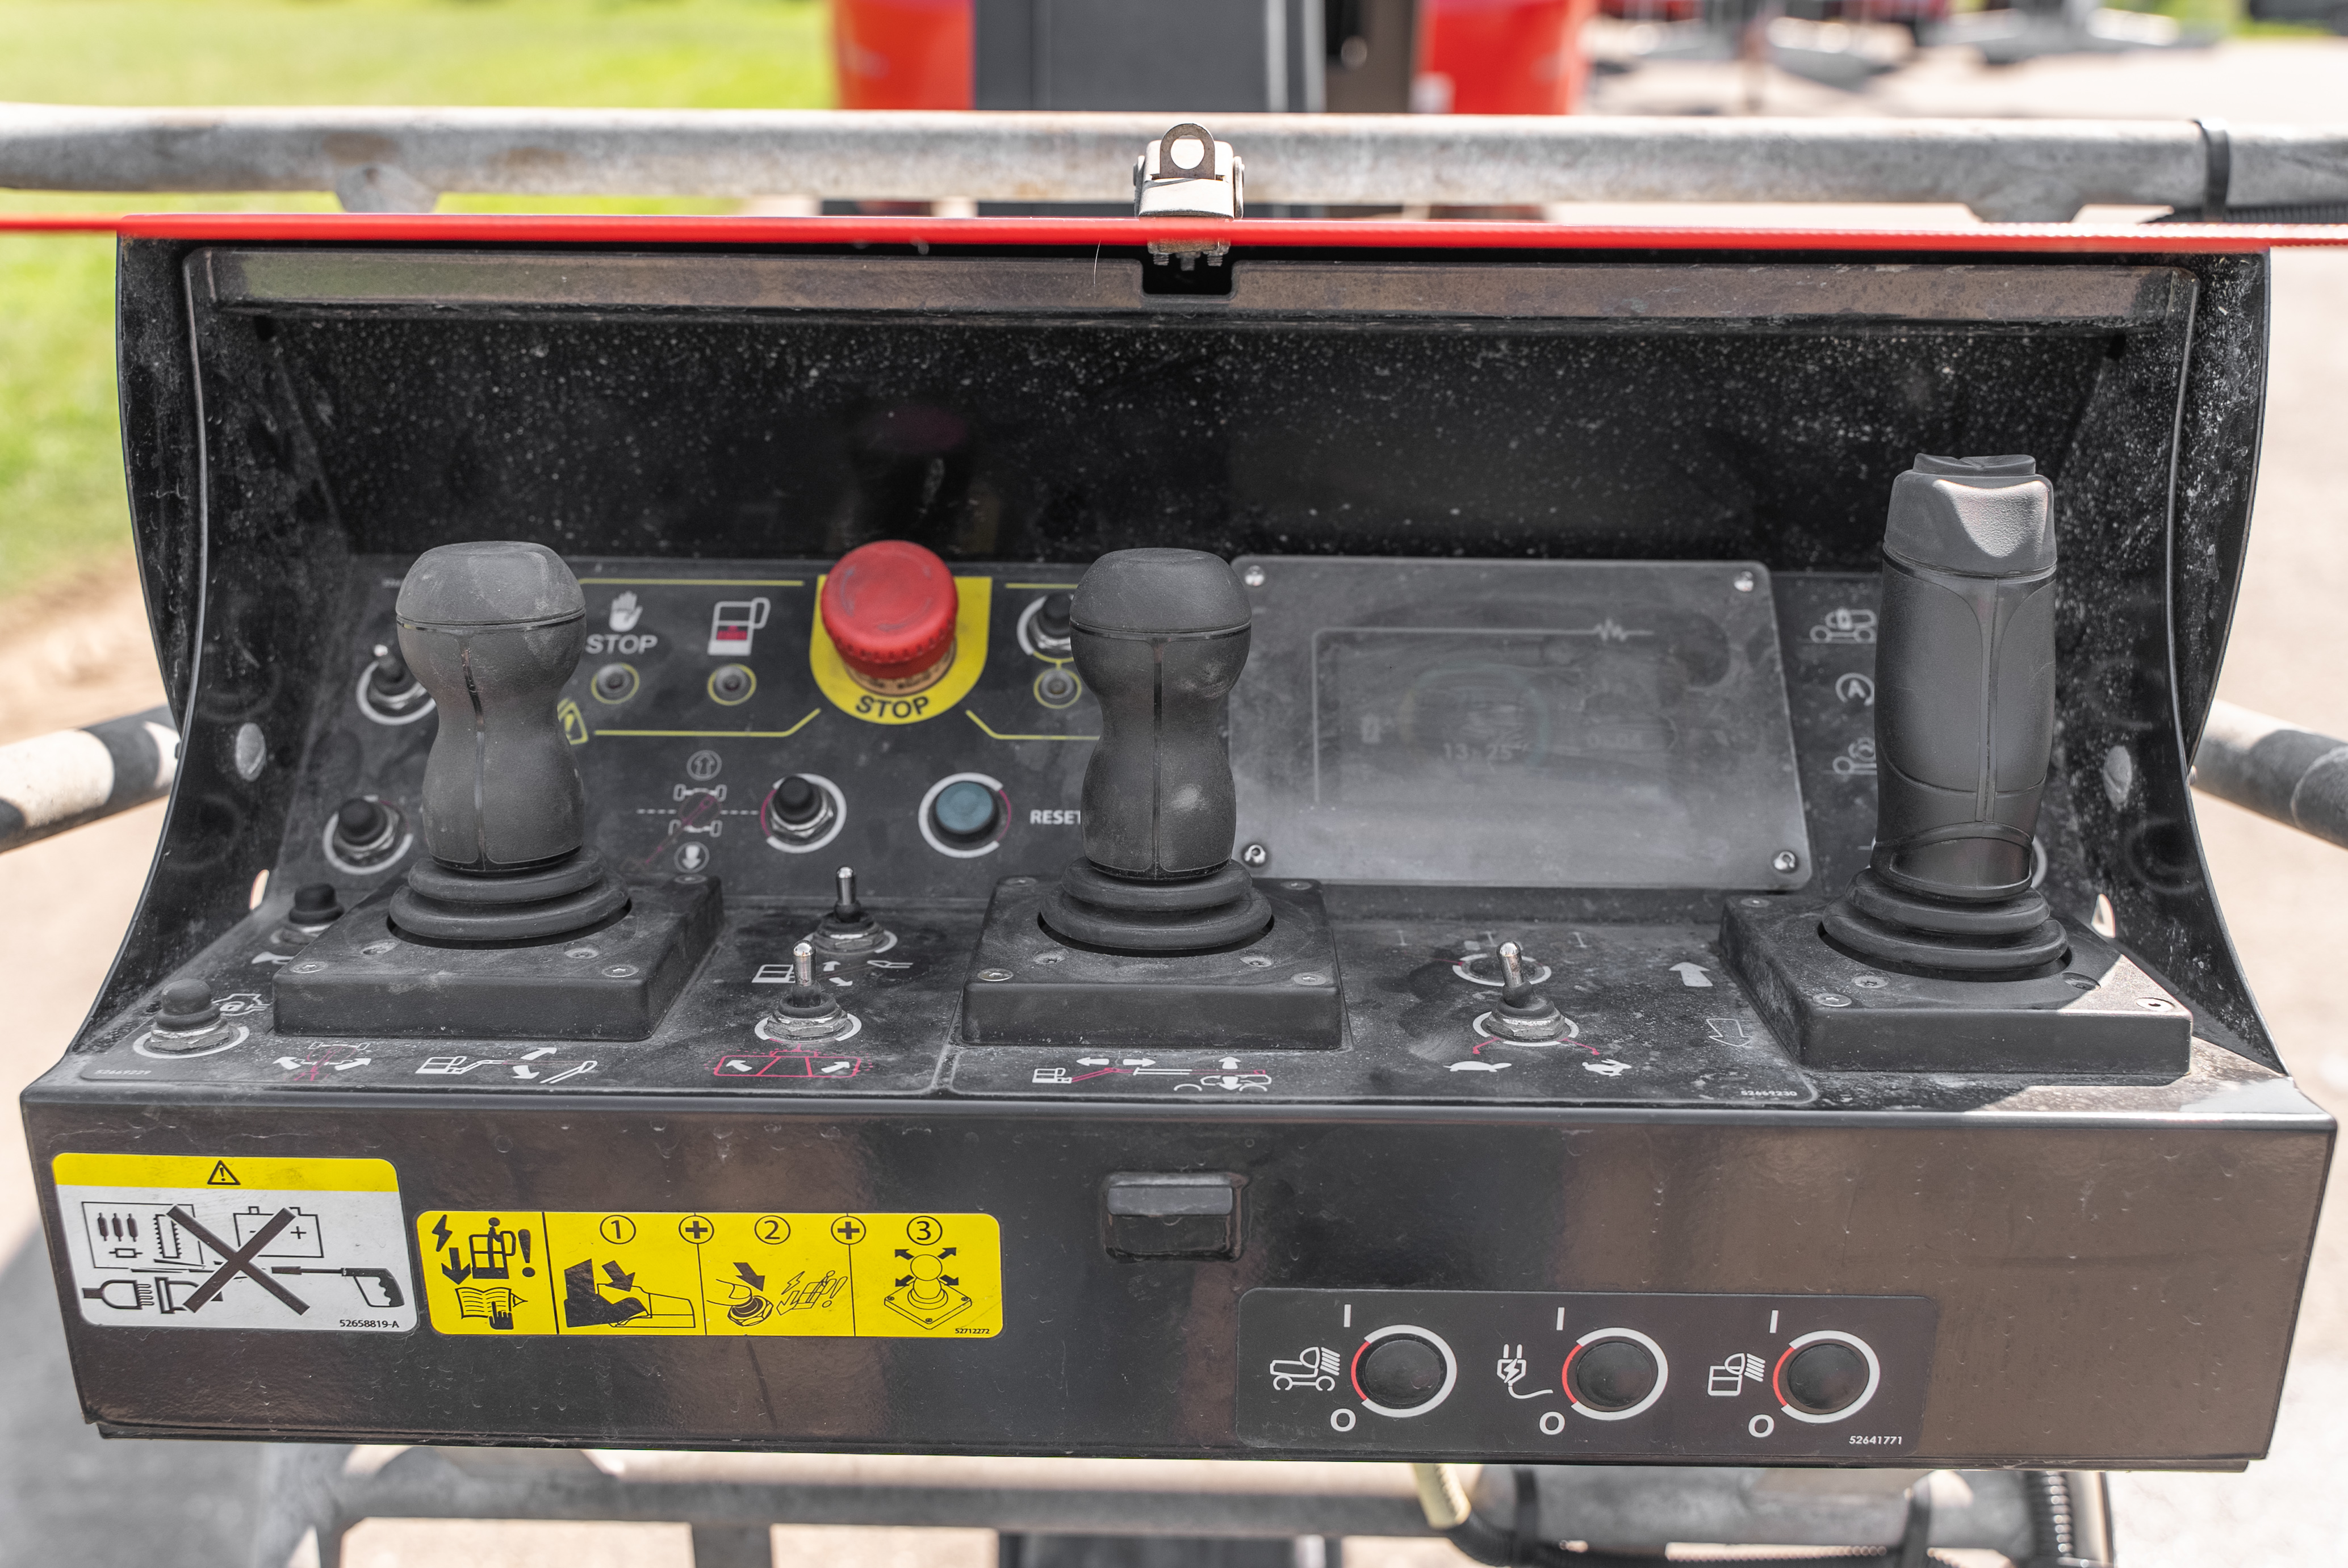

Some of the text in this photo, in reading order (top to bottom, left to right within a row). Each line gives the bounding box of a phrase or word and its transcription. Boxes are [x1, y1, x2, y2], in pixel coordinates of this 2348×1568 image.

[585, 634, 658, 654] STOP
[856, 695, 928, 718] STOP
[764, 1220, 780, 1239] 2
[916, 1221, 931, 1240] 3
[340, 1319, 400, 1328] 52658819-A
[1849, 1435, 1902, 1445] 52641771
